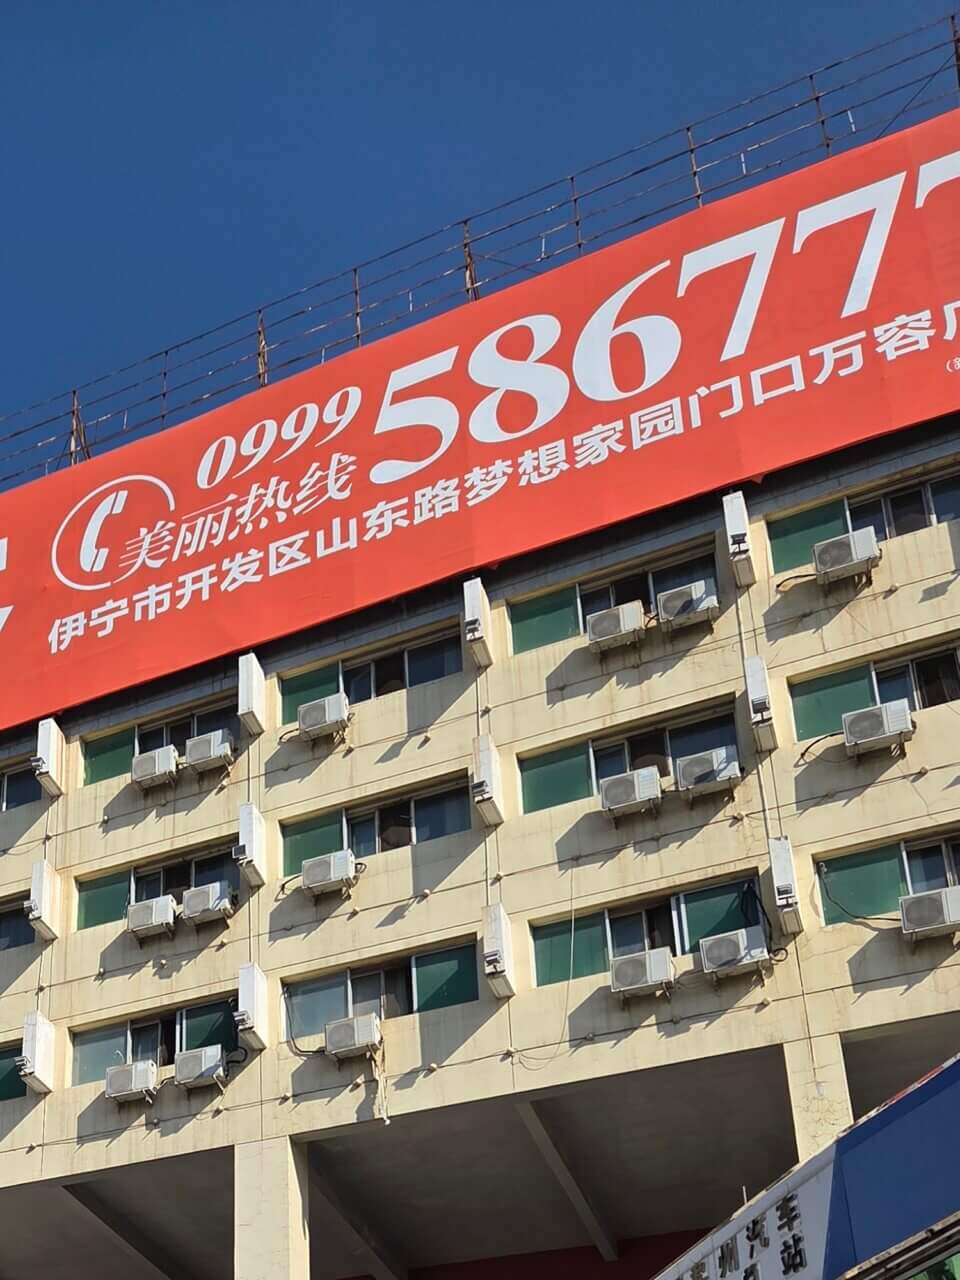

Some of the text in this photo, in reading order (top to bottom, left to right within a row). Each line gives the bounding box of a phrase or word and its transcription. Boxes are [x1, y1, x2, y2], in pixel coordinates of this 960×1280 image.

[195, 385, 362, 490] 0999
[113, 452, 357, 584] 美丽热线
